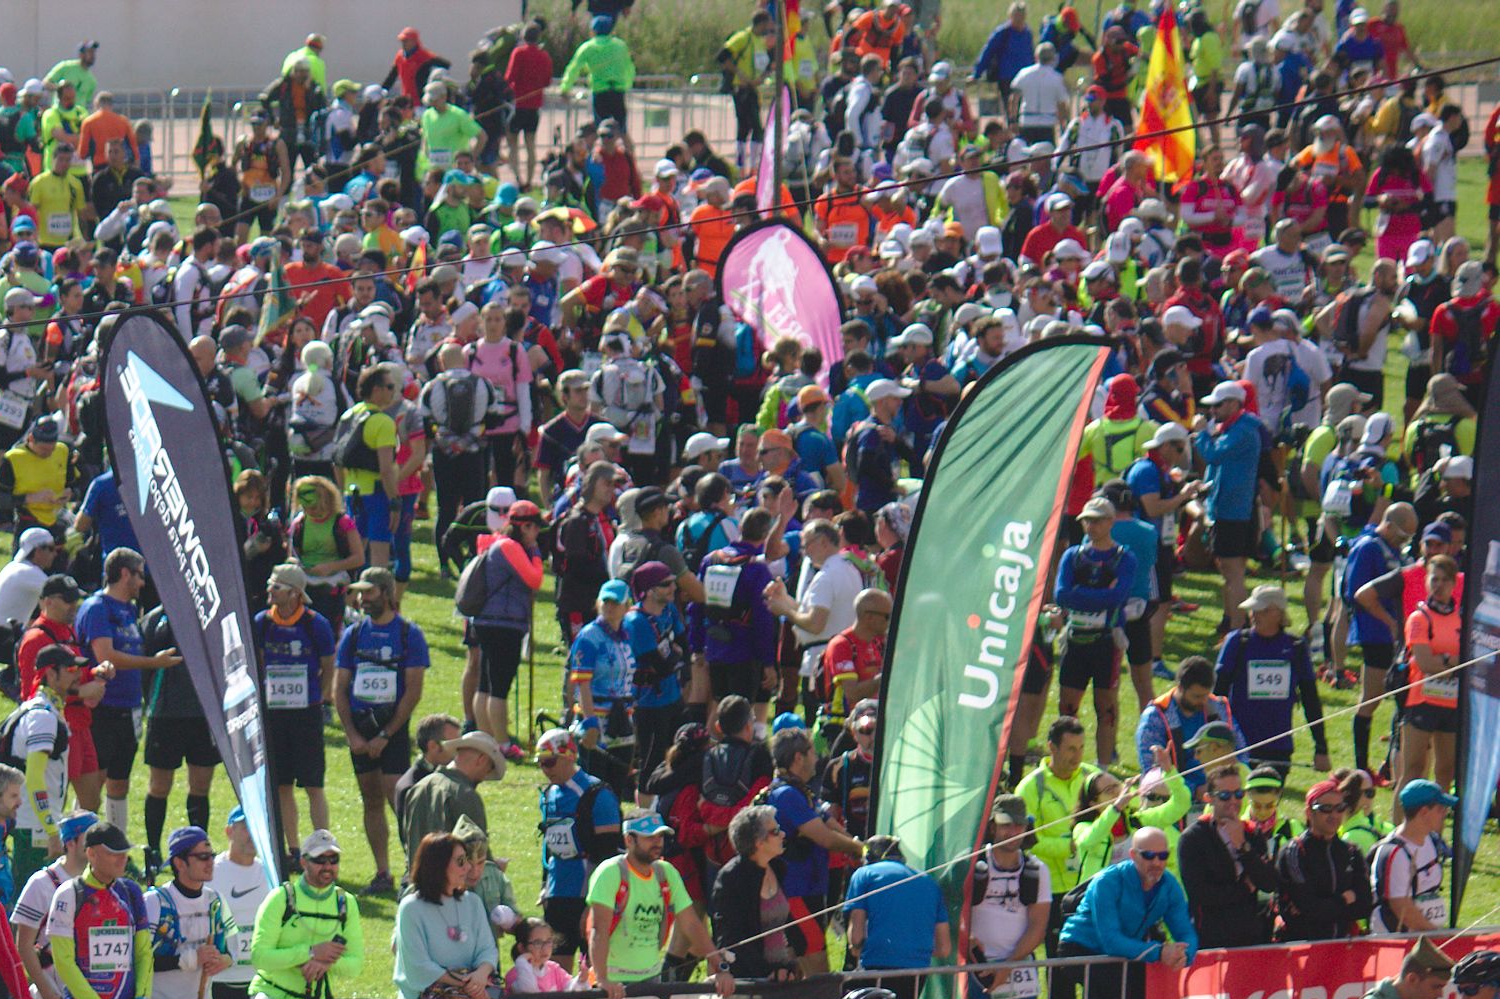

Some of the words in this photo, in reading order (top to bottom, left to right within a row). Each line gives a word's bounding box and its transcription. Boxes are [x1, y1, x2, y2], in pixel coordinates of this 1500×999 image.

[958, 520, 1035, 710] Unicaja
[362, 678, 389, 690] 563
[93, 942, 130, 957] 1747
